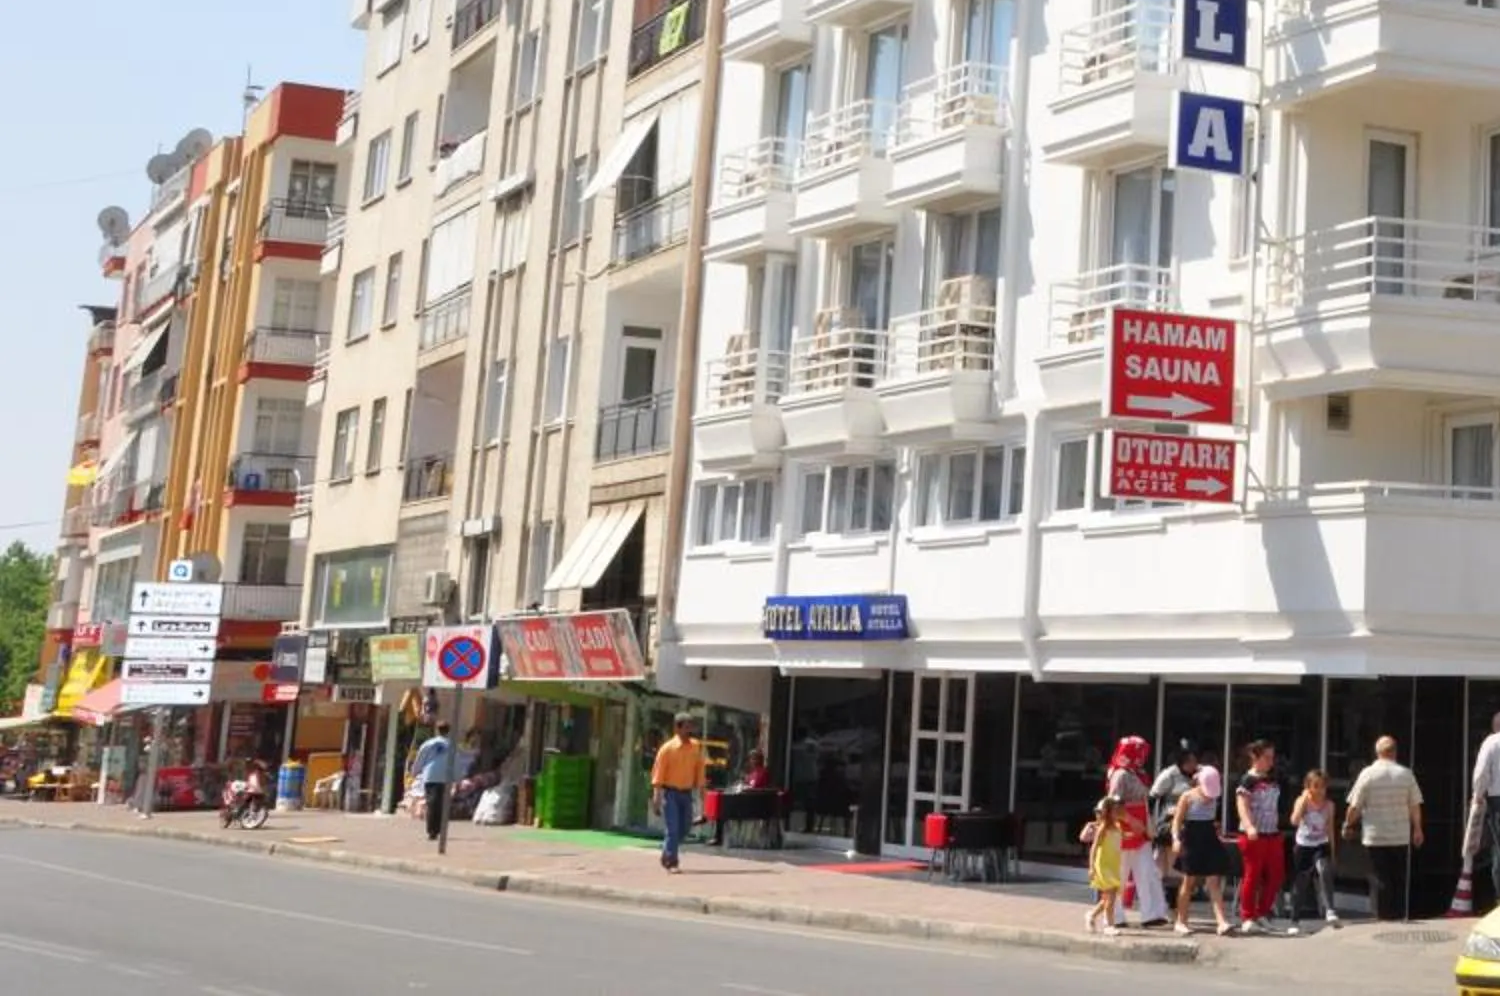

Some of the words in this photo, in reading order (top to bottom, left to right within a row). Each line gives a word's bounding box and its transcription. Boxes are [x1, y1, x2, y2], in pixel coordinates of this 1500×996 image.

[1122, 318, 1227, 351] HAMAM
[1125, 355, 1221, 386] SAUNA
[1117, 437, 1231, 470] OTOPARK
